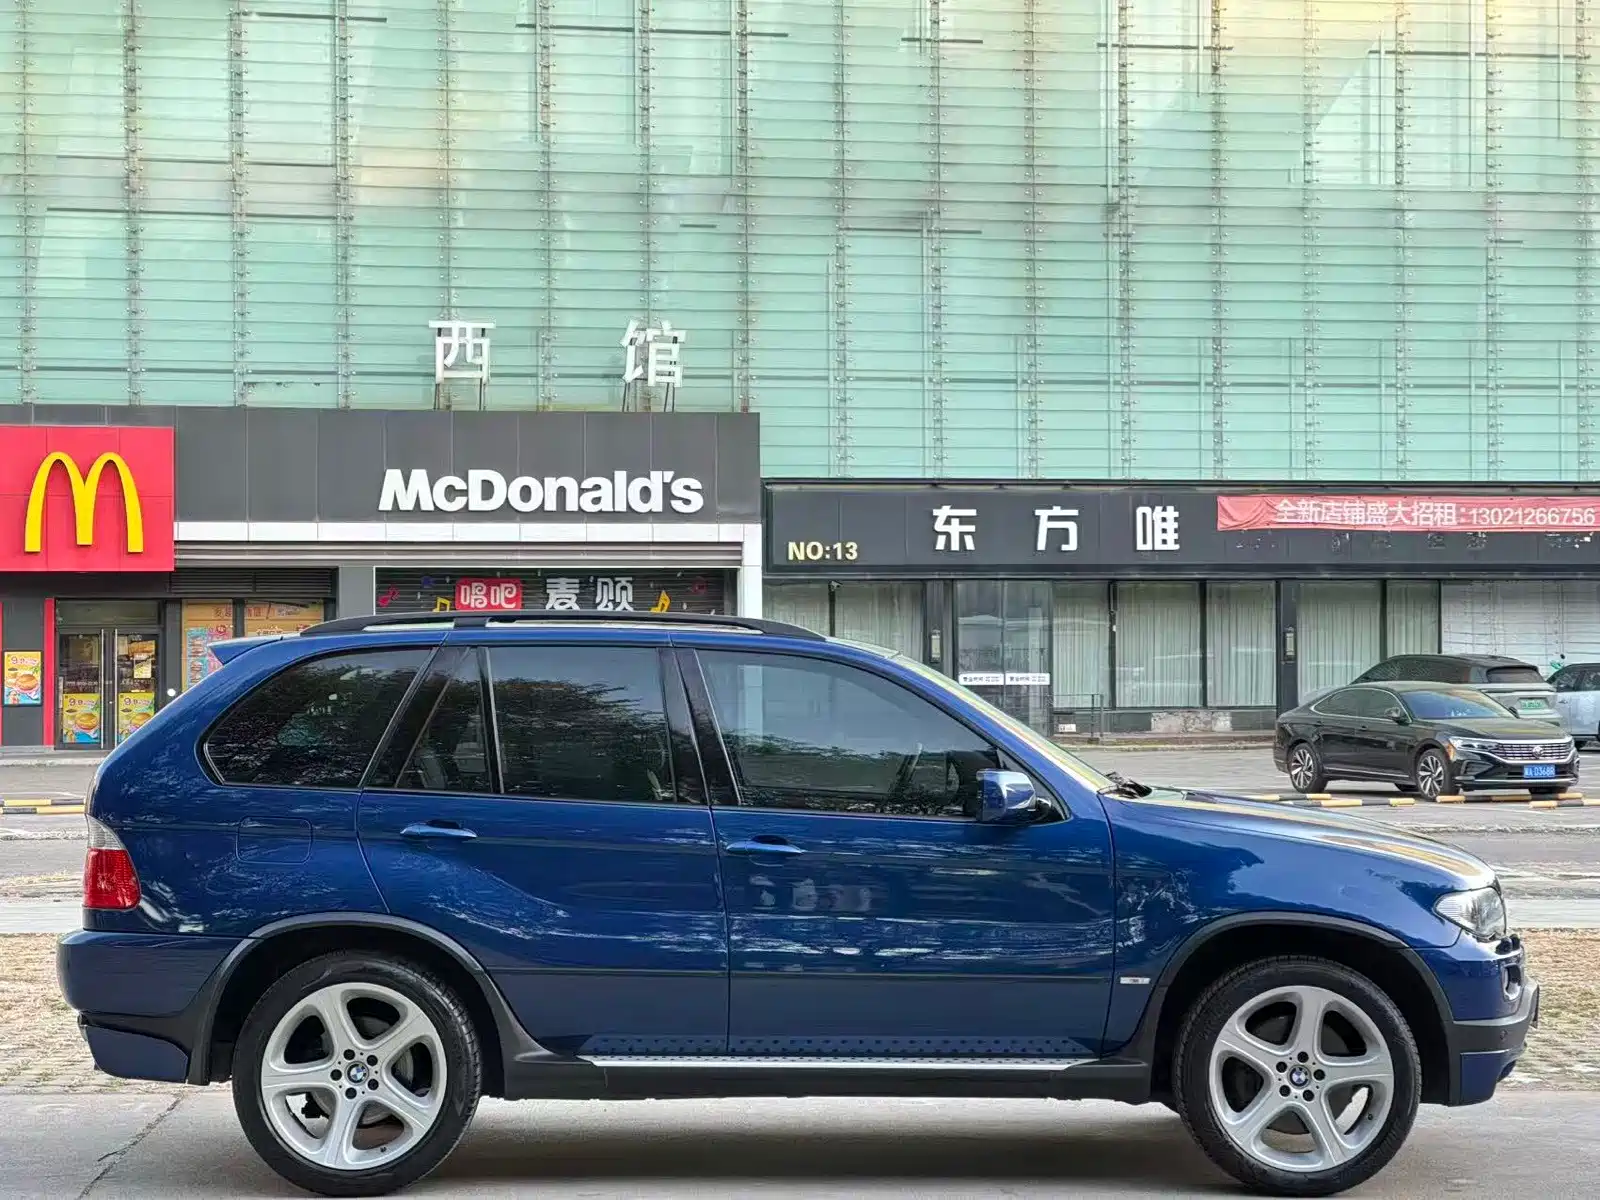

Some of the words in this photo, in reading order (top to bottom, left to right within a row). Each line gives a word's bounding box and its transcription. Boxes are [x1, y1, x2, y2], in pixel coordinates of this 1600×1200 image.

[429, 320, 686, 387] 西馆
[379, 468, 703, 513] McDonald's
[787, 540, 858, 561] NO:13
[932, 505, 1180, 551] 东方唯
[460, 582, 517, 608] 唱吧
[545, 576, 634, 611] 麦颂
